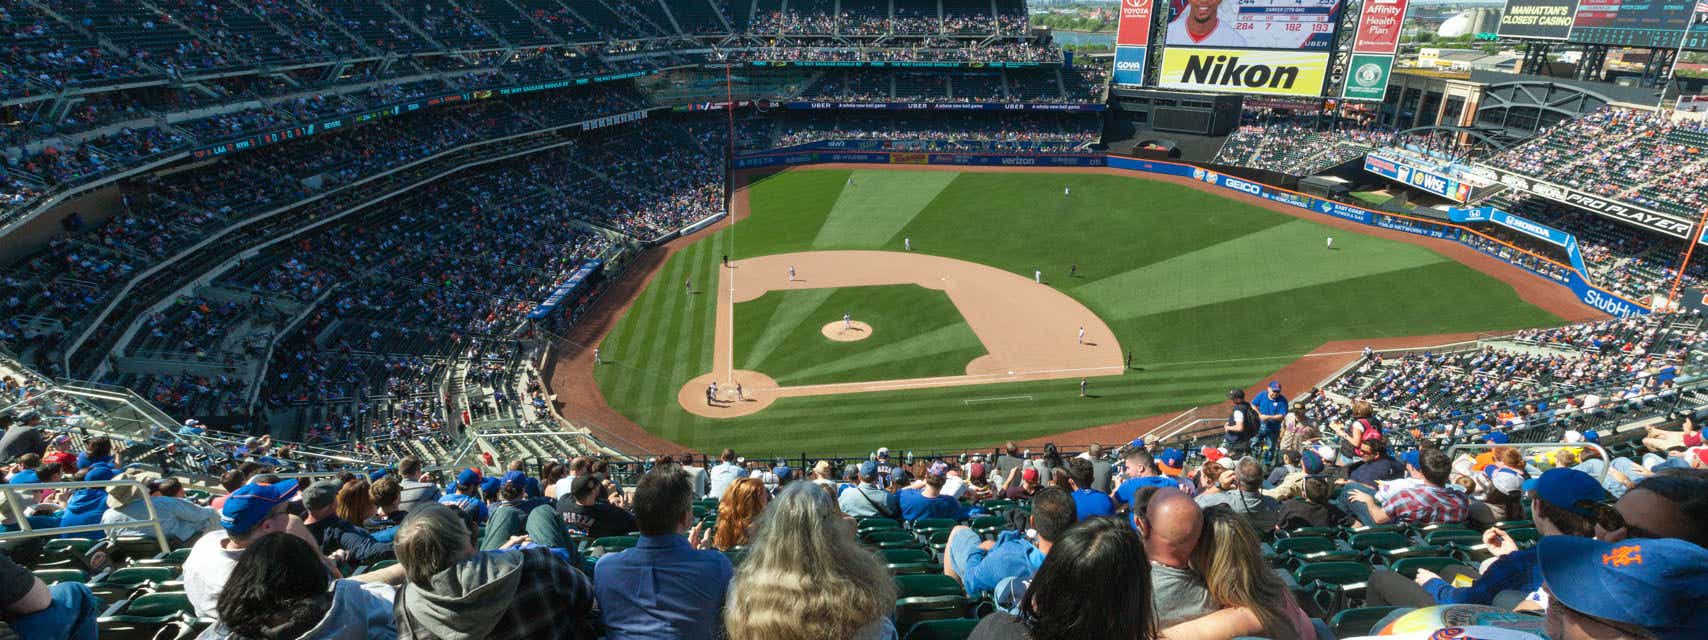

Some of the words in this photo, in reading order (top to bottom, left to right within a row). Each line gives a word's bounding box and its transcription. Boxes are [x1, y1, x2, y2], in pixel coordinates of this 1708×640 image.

[1367, 5, 1402, 15] Affinity
[1510, 6, 1569, 15] MANHATTAN'S
[1366, 16, 1397, 25] Health
[1502, 15, 1538, 25] CLOSEST
[1538, 16, 1572, 26] CASINO
[1369, 25, 1389, 34] Plan
[1117, 61, 1141, 69] GOYA
[1180, 54, 1300, 90] Nikon
[1001, 155, 1035, 165] verizon
[1225, 178, 1260, 194] GEICO
[1424, 173, 1446, 193] WISE
[1566, 193, 1606, 209] PRO
[1604, 204, 1688, 233] PLAYER
[1511, 219, 1551, 238] HONDA
